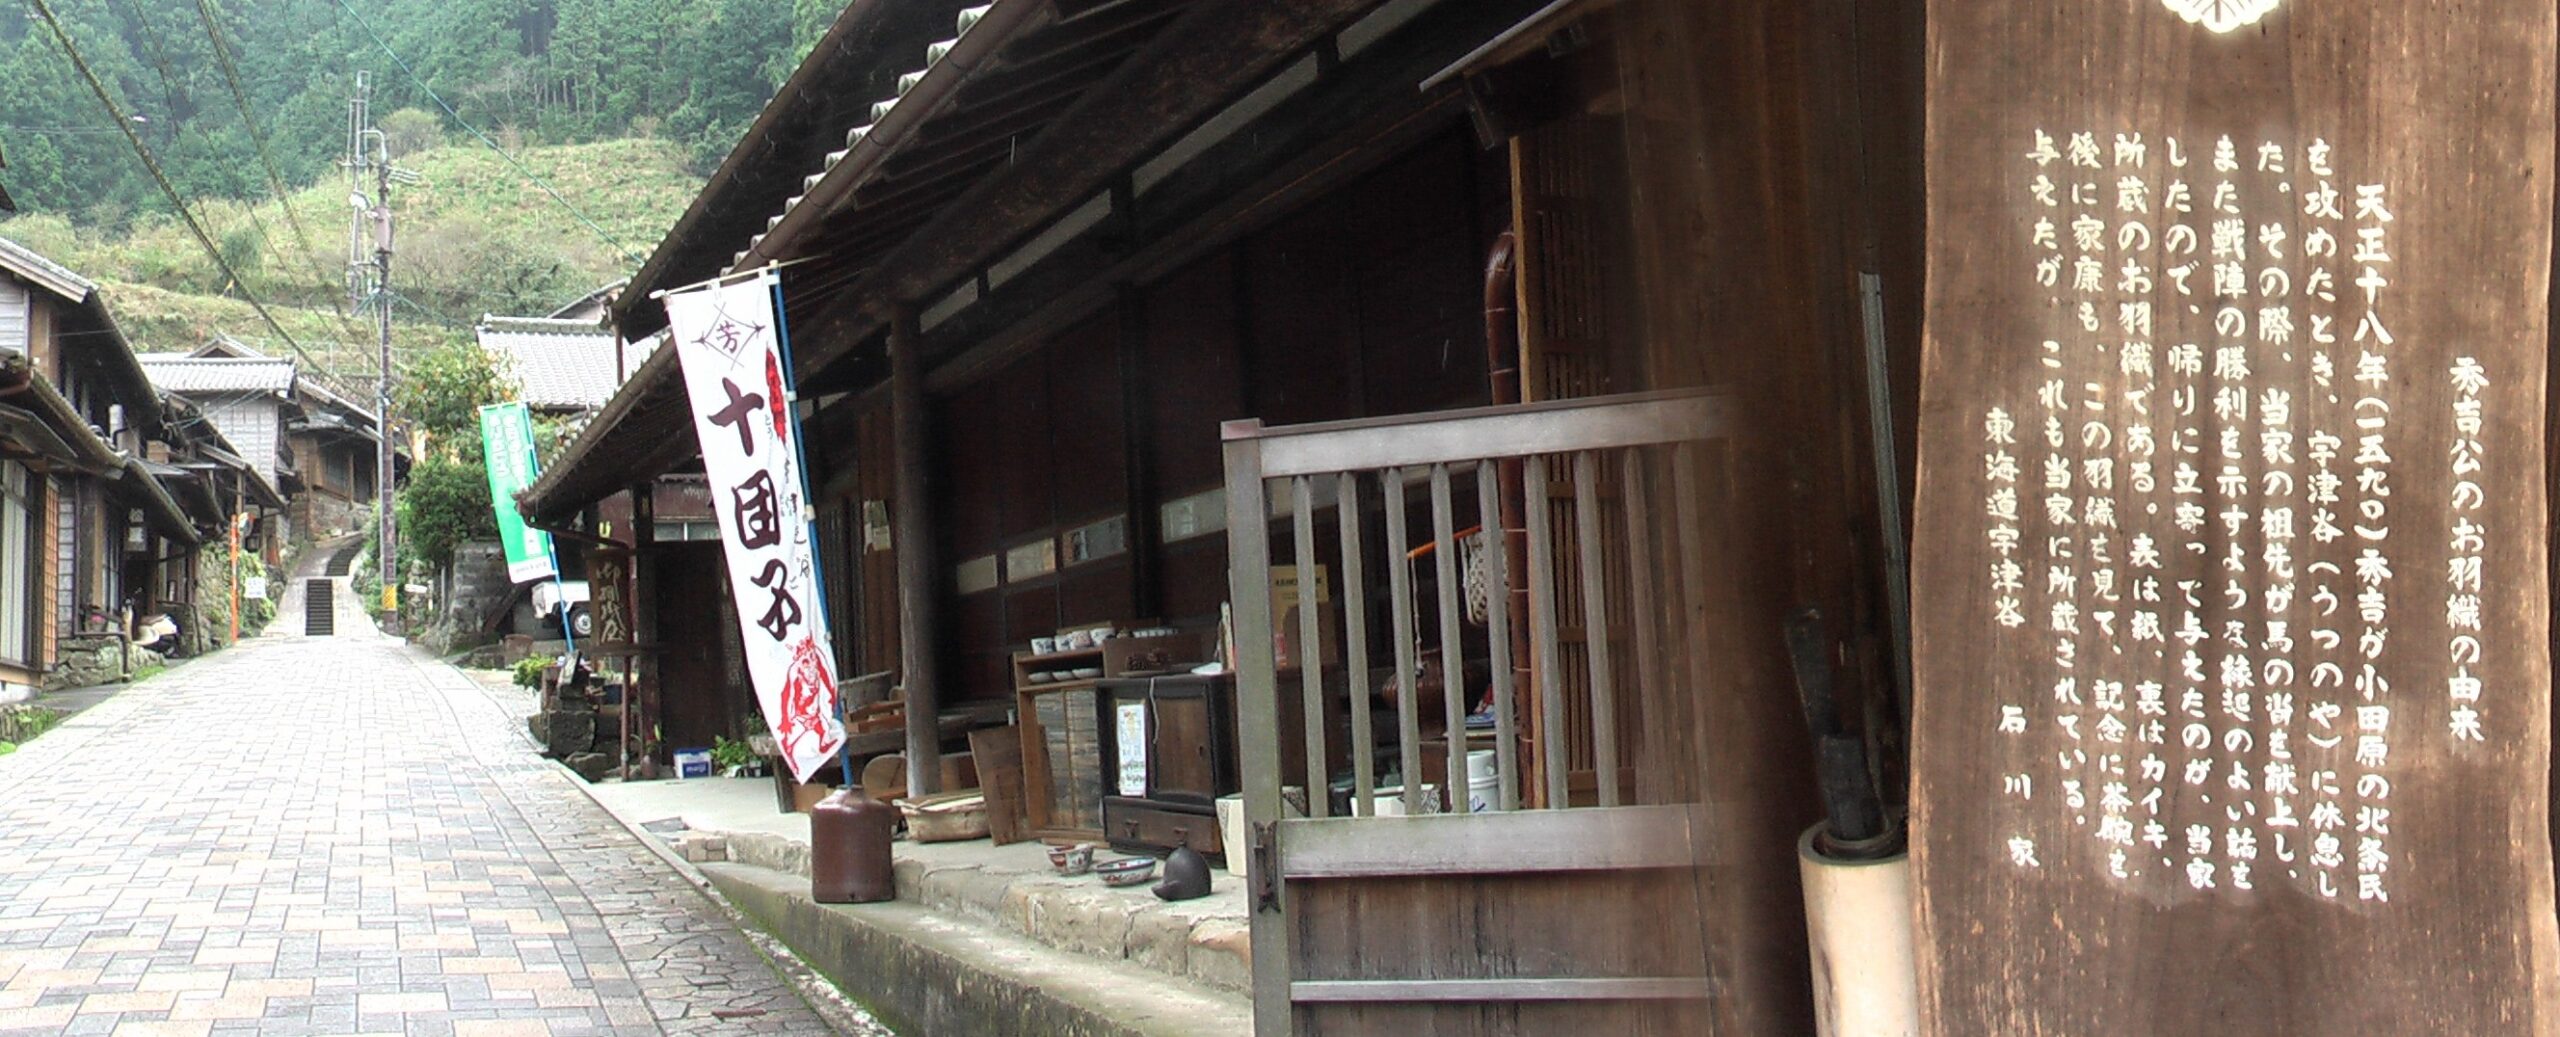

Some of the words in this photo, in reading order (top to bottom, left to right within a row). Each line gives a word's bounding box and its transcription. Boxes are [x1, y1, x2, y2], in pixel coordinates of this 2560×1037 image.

[716, 320, 741, 354] 芳
[1986, 407, 2025, 628] 東海道宇津谷
[2447, 357, 2489, 741] 秀吉公のお羽織の由来
